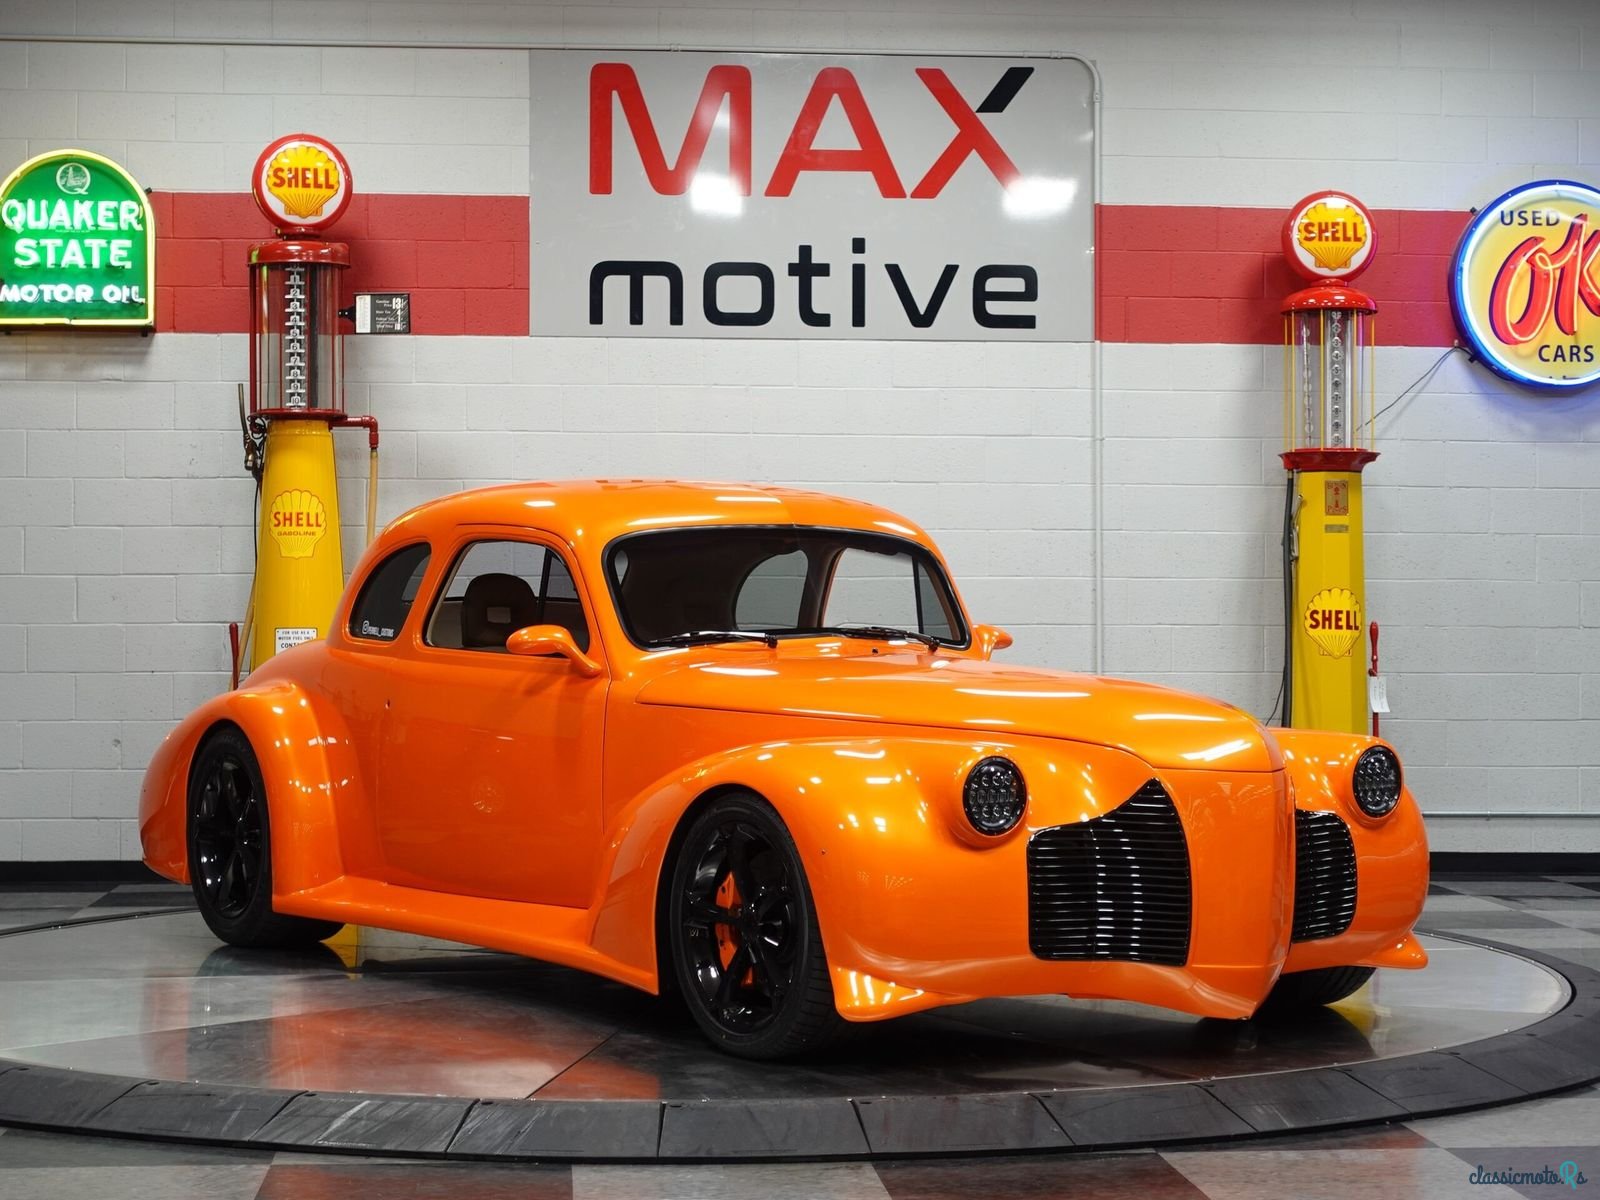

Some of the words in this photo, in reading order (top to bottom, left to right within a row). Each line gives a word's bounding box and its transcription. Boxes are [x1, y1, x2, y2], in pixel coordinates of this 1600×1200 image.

[589, 62, 1035, 199] MAX
[272, 167, 335, 189] SHELL
[1, 198, 144, 234] QUAKER
[1500, 210, 1560, 226] USED
[1303, 222, 1362, 242] SHELL
[14, 238, 132, 269] STATE
[0, 283, 95, 304] MOTOR
[101, 284, 146, 304] OIL
[589, 237, 1039, 330] motive
[1538, 345, 1594, 363] CARS
[273, 511, 322, 528] SHELL
[1309, 609, 1360, 631] SHELL
